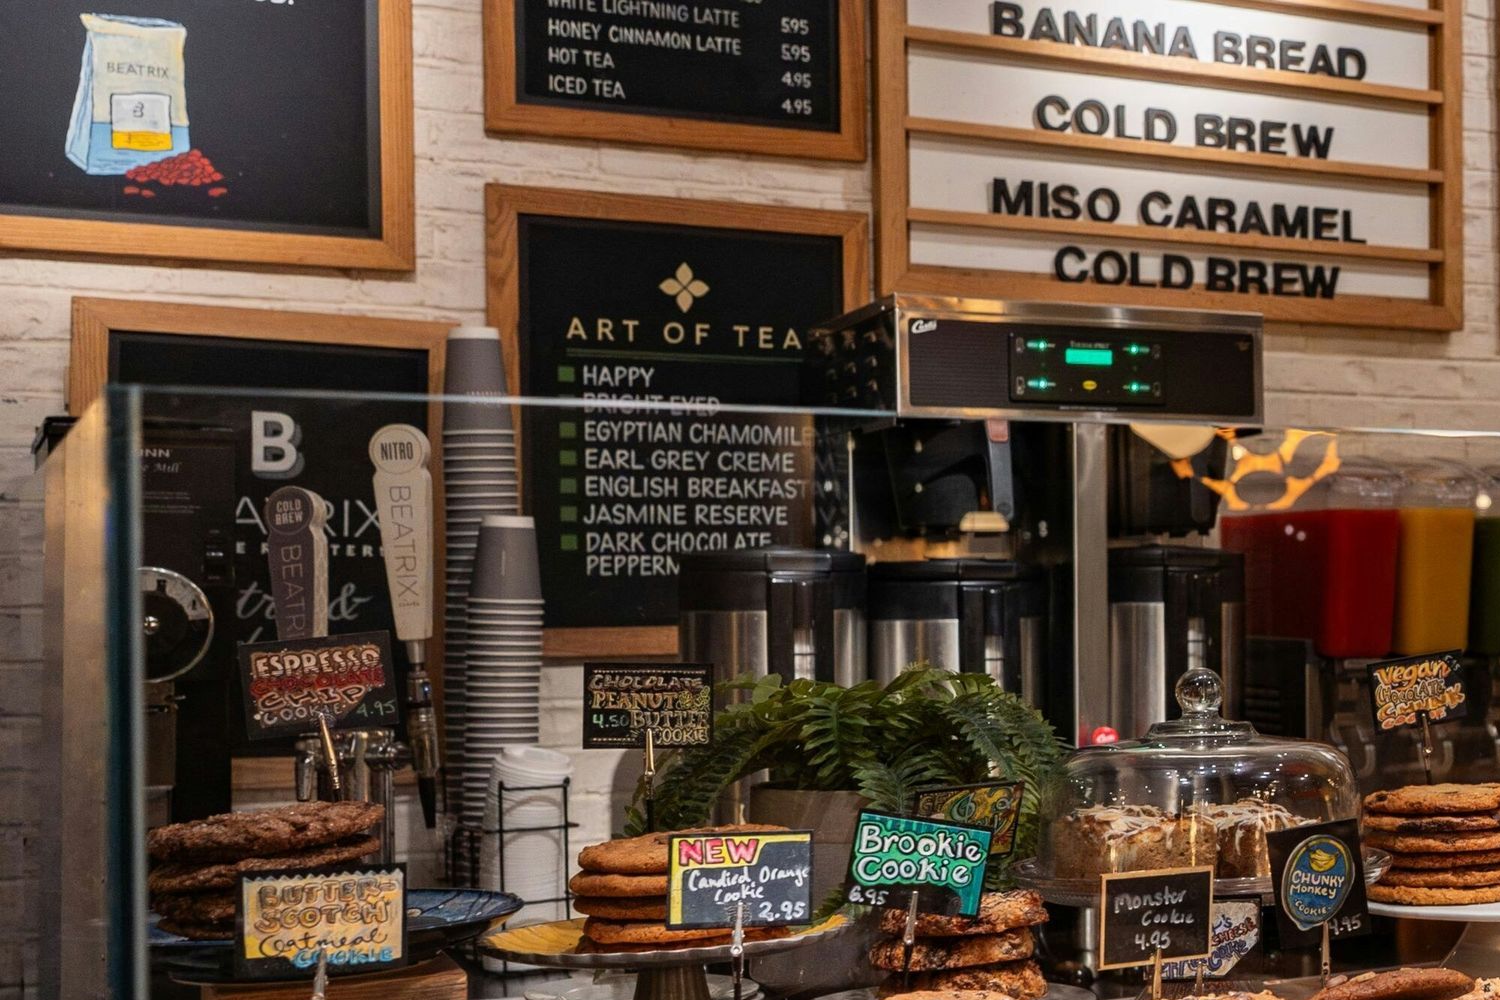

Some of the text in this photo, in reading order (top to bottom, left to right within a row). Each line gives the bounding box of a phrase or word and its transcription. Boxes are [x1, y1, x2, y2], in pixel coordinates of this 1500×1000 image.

[602, 0, 809, 35] LIGHTNING LATTE 5.95
[548, 18, 811, 62] HONEY CINNAMON LATTE 5.95
[990, 0, 1367, 81] BANANA BREAD
[106, 61, 170, 80] BEATRIX
[548, 48, 812, 89] HOT TEA 4.95
[548, 75, 812, 116] ICED TEA 4.95
[1034, 94, 1334, 160] COLD BREW
[990, 178, 1367, 245] MISO CARAMEL
[1054, 246, 1341, 299] COLD BREW
[566, 317, 802, 349] ART OF TEA
[582, 365, 655, 387] HAPPY
[252, 410, 300, 475] B
[584, 421, 682, 443] EGYPTIAN
[380, 441, 414, 460] NITRO
[584, 449, 795, 473] EARL GREY CREME
[585, 476, 808, 499] ENGLISH BREAKFAST
[275, 511, 303, 525] BREW
[276, 500, 301, 514] COLD
[583, 504, 788, 526] JASMINE RESERVE
[390, 485, 419, 597] BEATRIX
[586, 532, 772, 552] DARK CHOCOLATE
[280, 544, 306, 637] BEATRI
[255, 647, 381, 678] ESPRESSO
[1374, 659, 1452, 690] Vegan
[251, 667, 386, 697] CHOCOLATE
[589, 674, 703, 690] CHOCOLATE
[258, 684, 366, 711] CHIP
[356, 700, 396, 718] 4.95
[591, 691, 679, 709] PEANUT
[263, 703, 343, 725] COOKIE
[592, 713, 630, 729] 4.50
[629, 709, 710, 730] BUTTER
[679, 838, 760, 867] NEW
[858, 824, 982, 862] Brookie
[688, 865, 811, 892] Candied Orange
[857, 856, 970, 884] Cookie
[1292, 870, 1345, 888] CHUNKY
[714, 883, 764, 905] Cookie
[848, 885, 889, 905] 6.95
[1114, 886, 1187, 914] Monster
[1289, 884, 1336, 899] Monkey
[254, 899, 389, 934] SCOTCH
[758, 900, 806, 921] 2.95
[1141, 909, 1195, 927] Cookie
[1295, 899, 1327, 915] COOKIE
[259, 927, 388, 957] Oatmeal
[1134, 930, 1172, 951] 4.95
